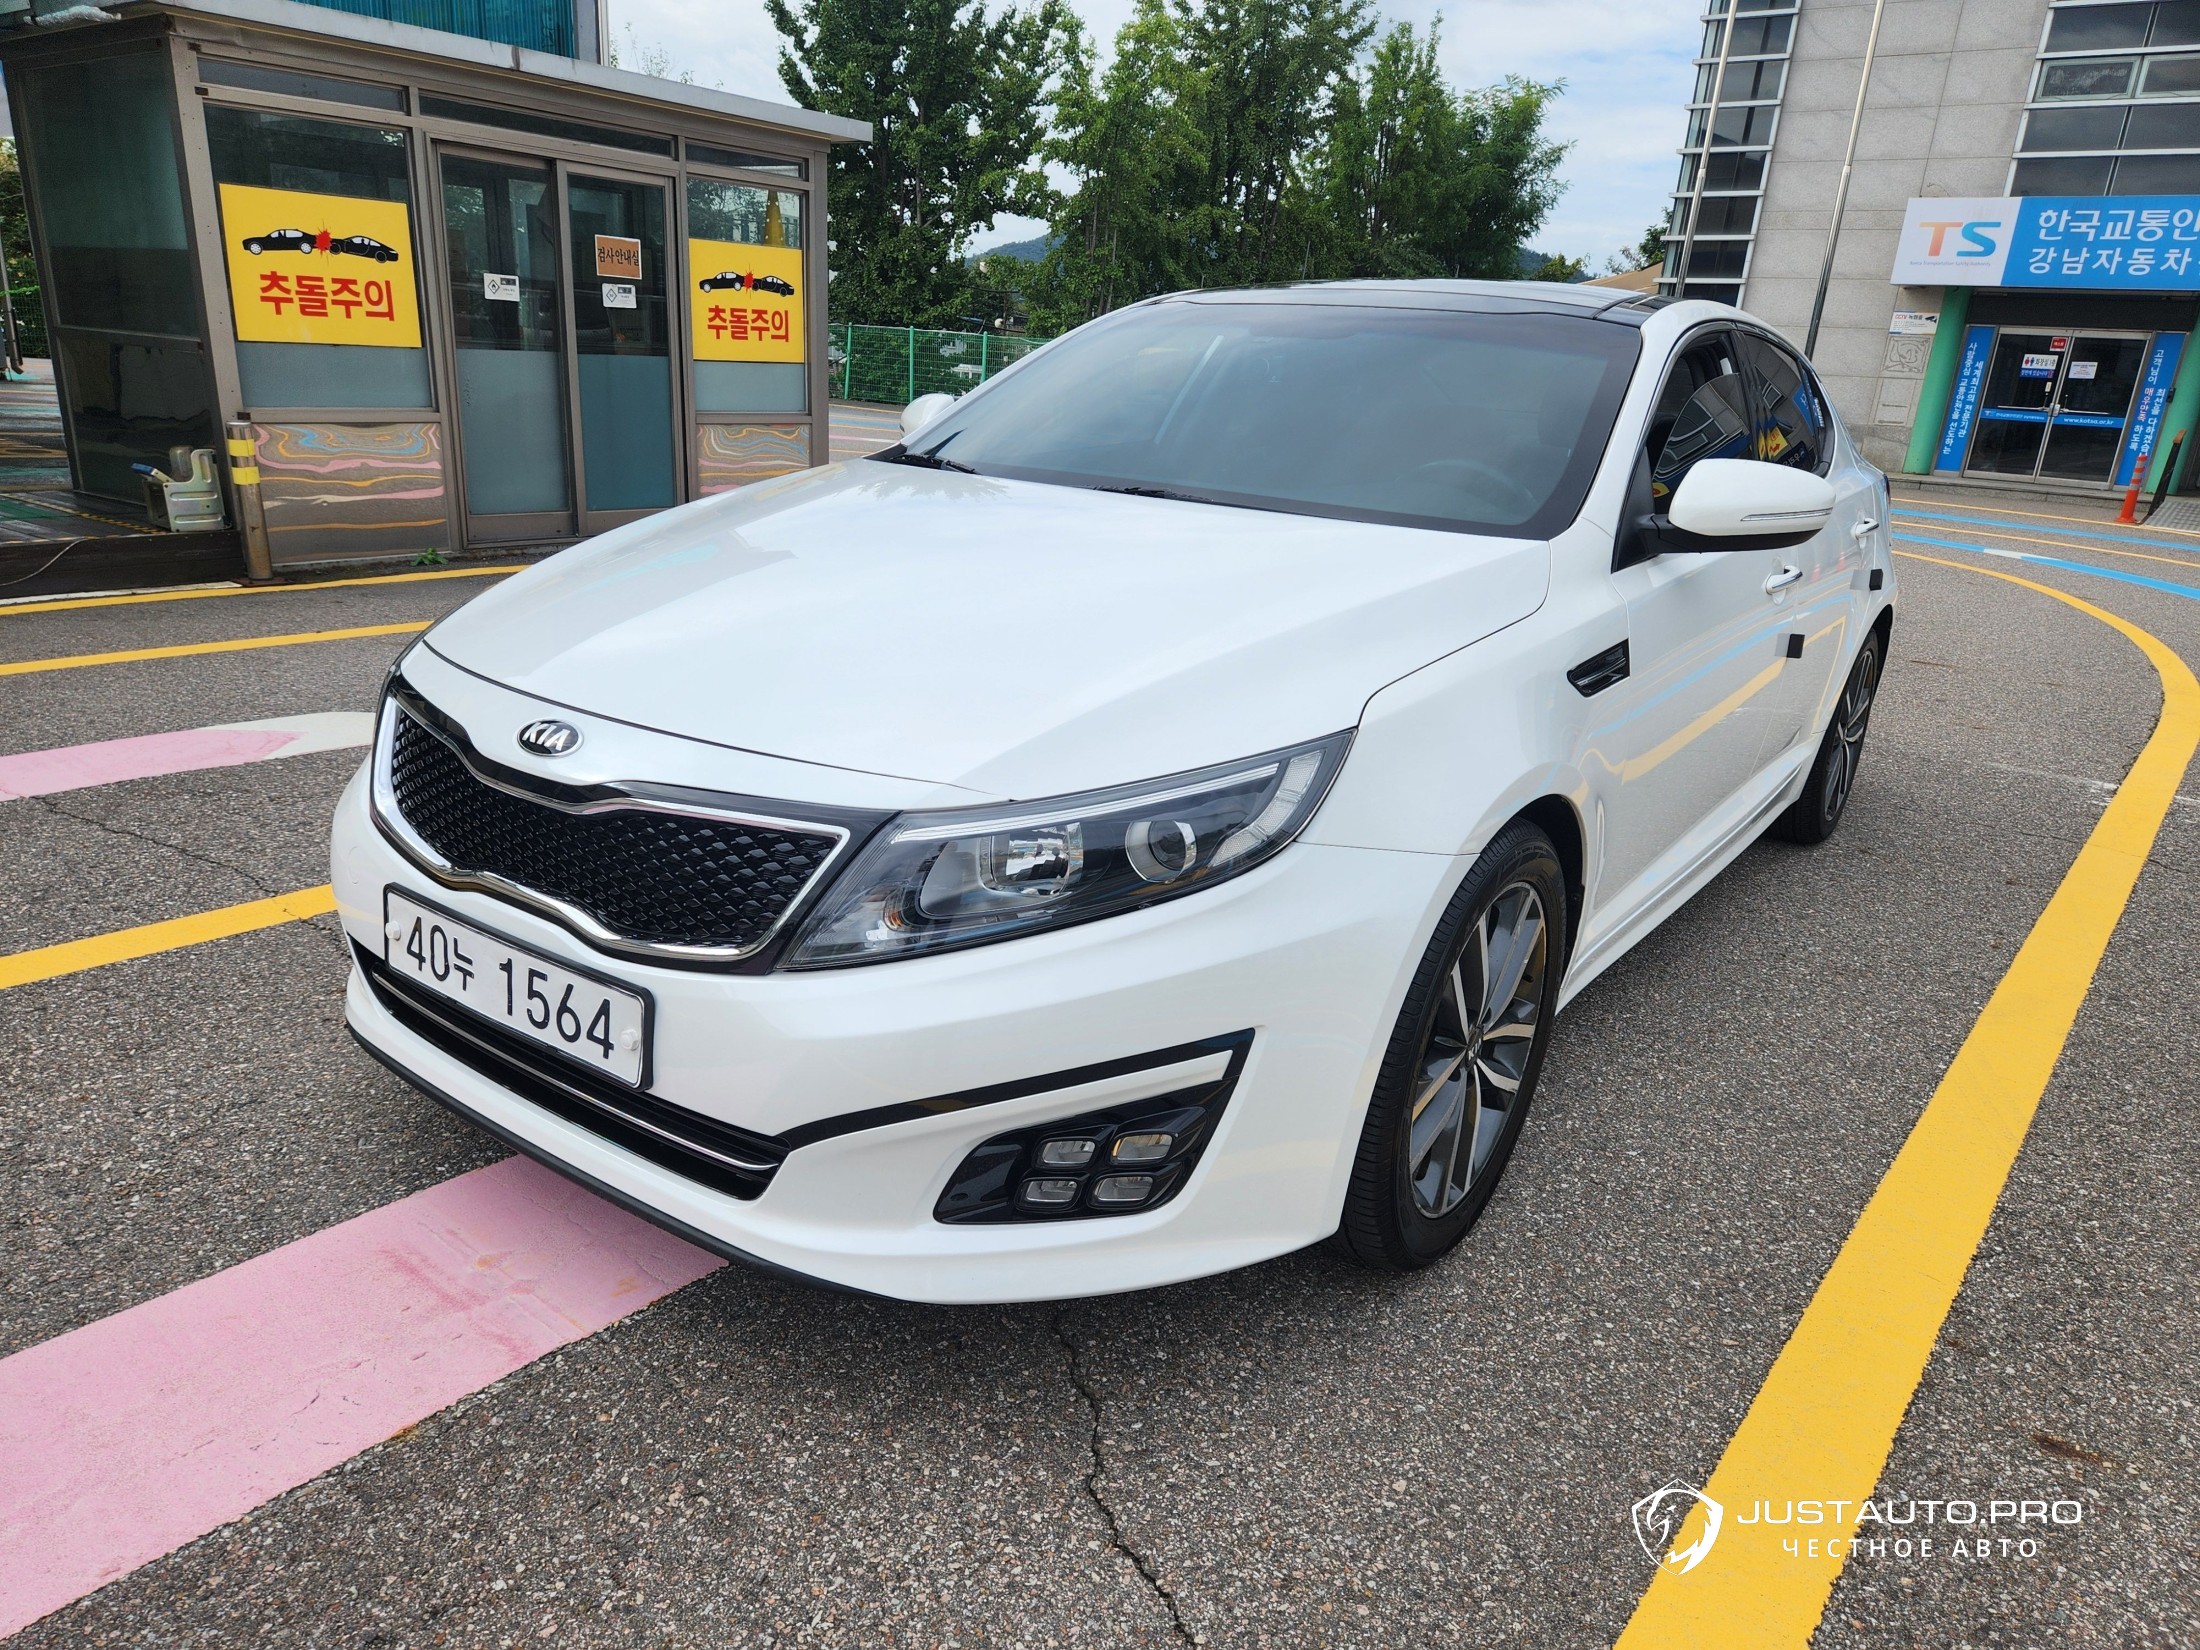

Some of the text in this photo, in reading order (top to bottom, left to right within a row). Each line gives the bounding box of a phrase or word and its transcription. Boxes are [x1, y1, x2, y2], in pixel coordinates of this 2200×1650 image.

[1919, 221, 2002, 257] TS
[2029, 247, 2200, 276] 강남자동차
[259, 271, 395, 322] 추돌주의
[707, 304, 790, 343] 추돌주의
[2147, 349, 2164, 385] 고객님이
[2063, 417, 2114, 425] www.kotsa.or.kr
[2138, 417, 2158, 456] 다하겠습
[521, 720, 570, 751] KIA
[406, 916, 615, 1060] 40누 1564
